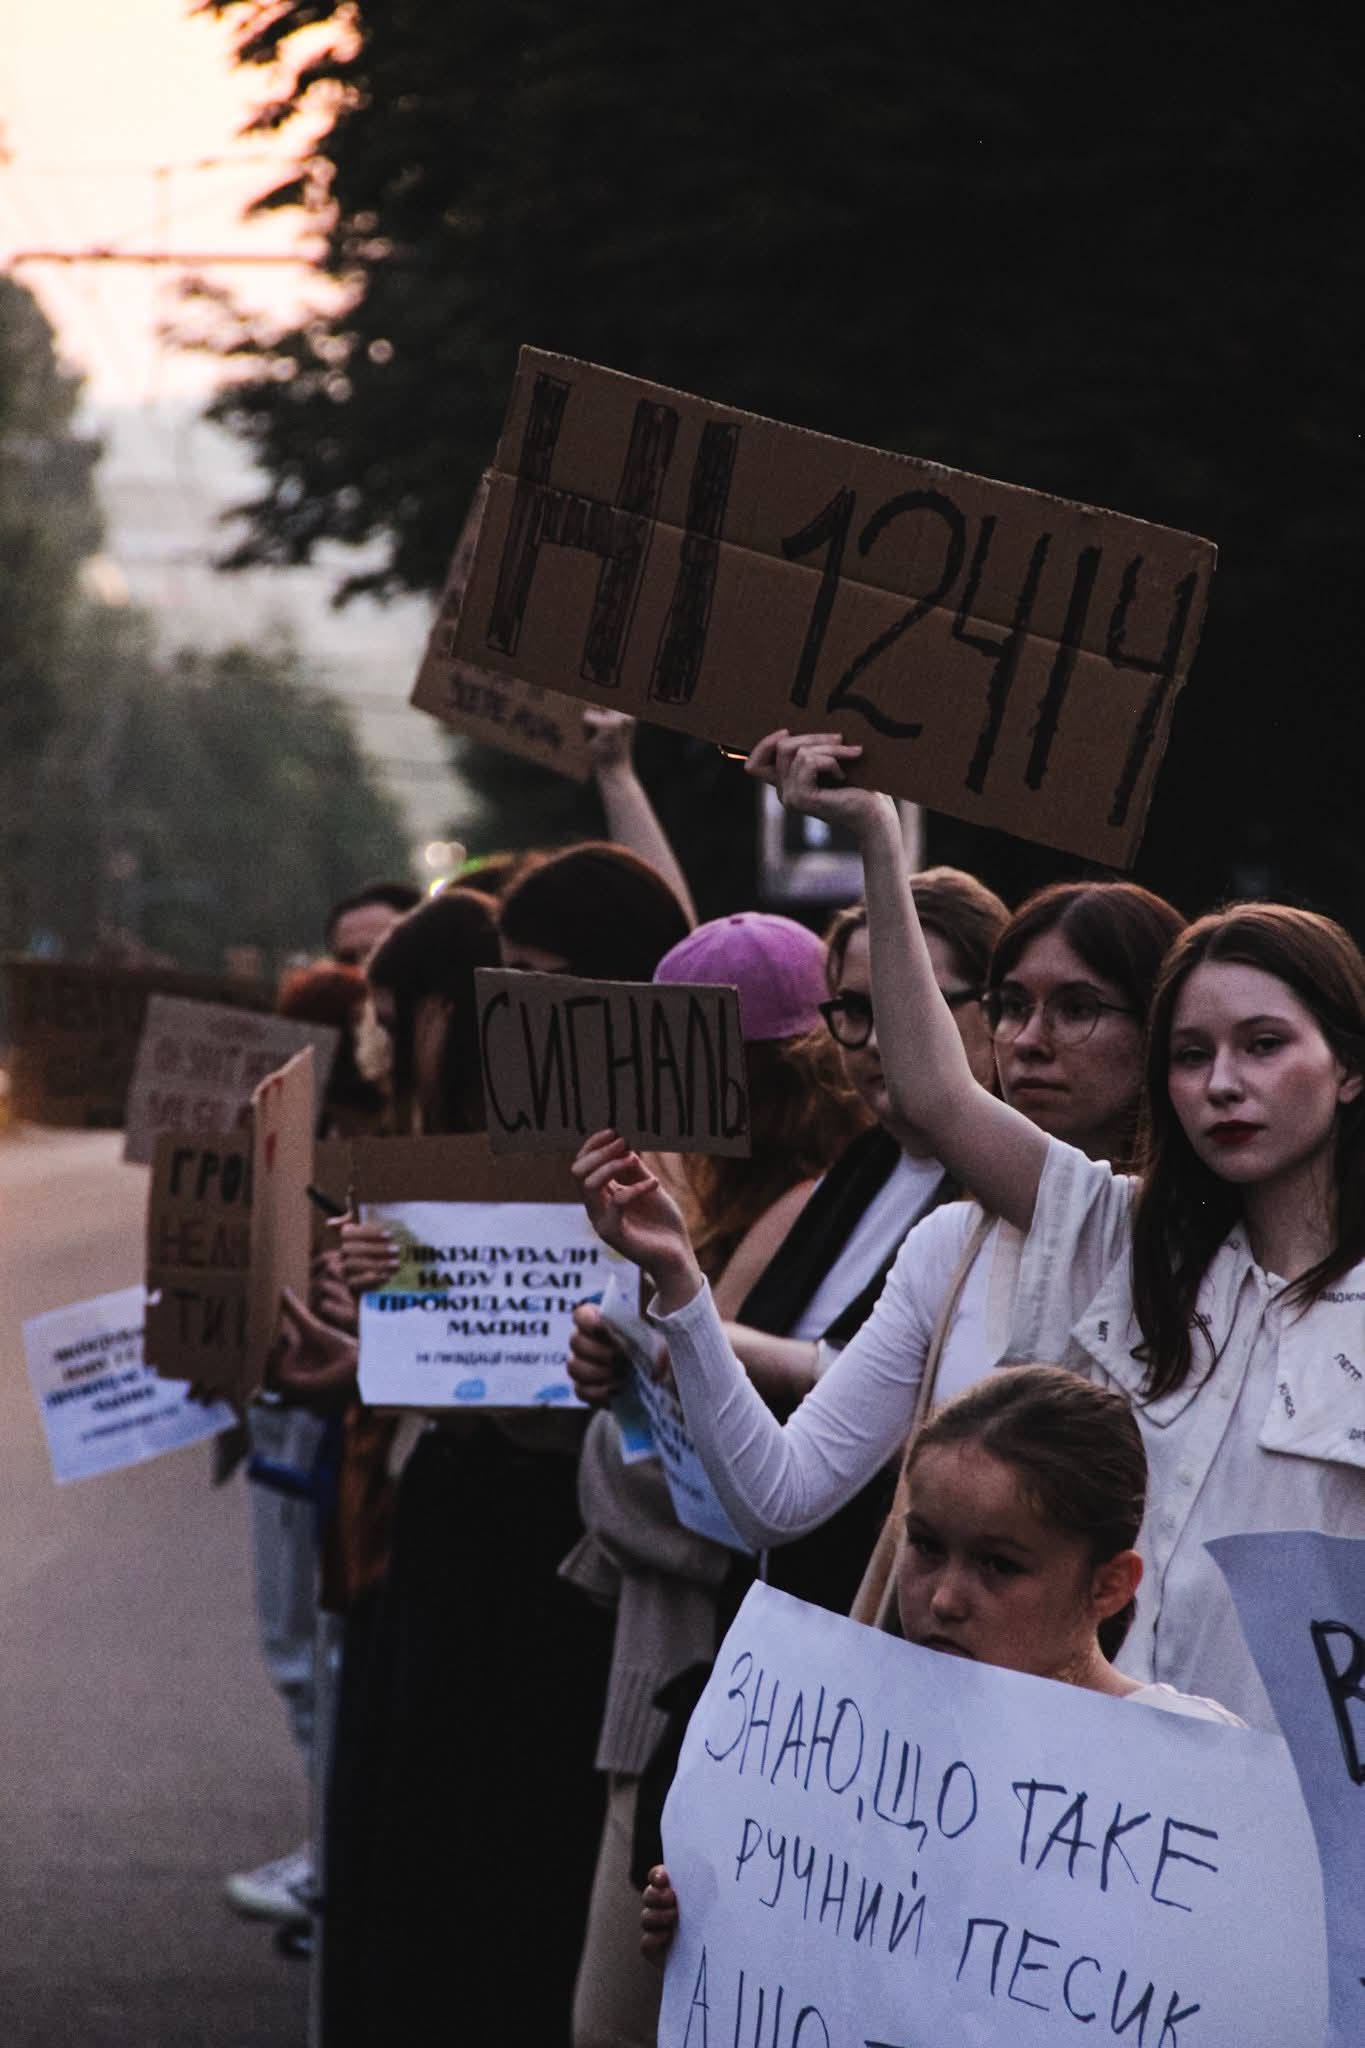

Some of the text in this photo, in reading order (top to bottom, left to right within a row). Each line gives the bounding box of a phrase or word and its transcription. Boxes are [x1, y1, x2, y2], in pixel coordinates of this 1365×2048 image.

[781, 486, 1199, 827] 12414
[481, 991, 749, 1138] СИГНАЛЬ
[379, 1294, 579, 1315] ПРОКИДАЄТЬ
[447, 1320, 550, 1336] МАФІЯ
[736, 1818, 926, 1955] РУЧНИЙ
[1012, 1778, 1219, 1911] ТАКЕ
[957, 1918, 1201, 2048] ПЕСИК
